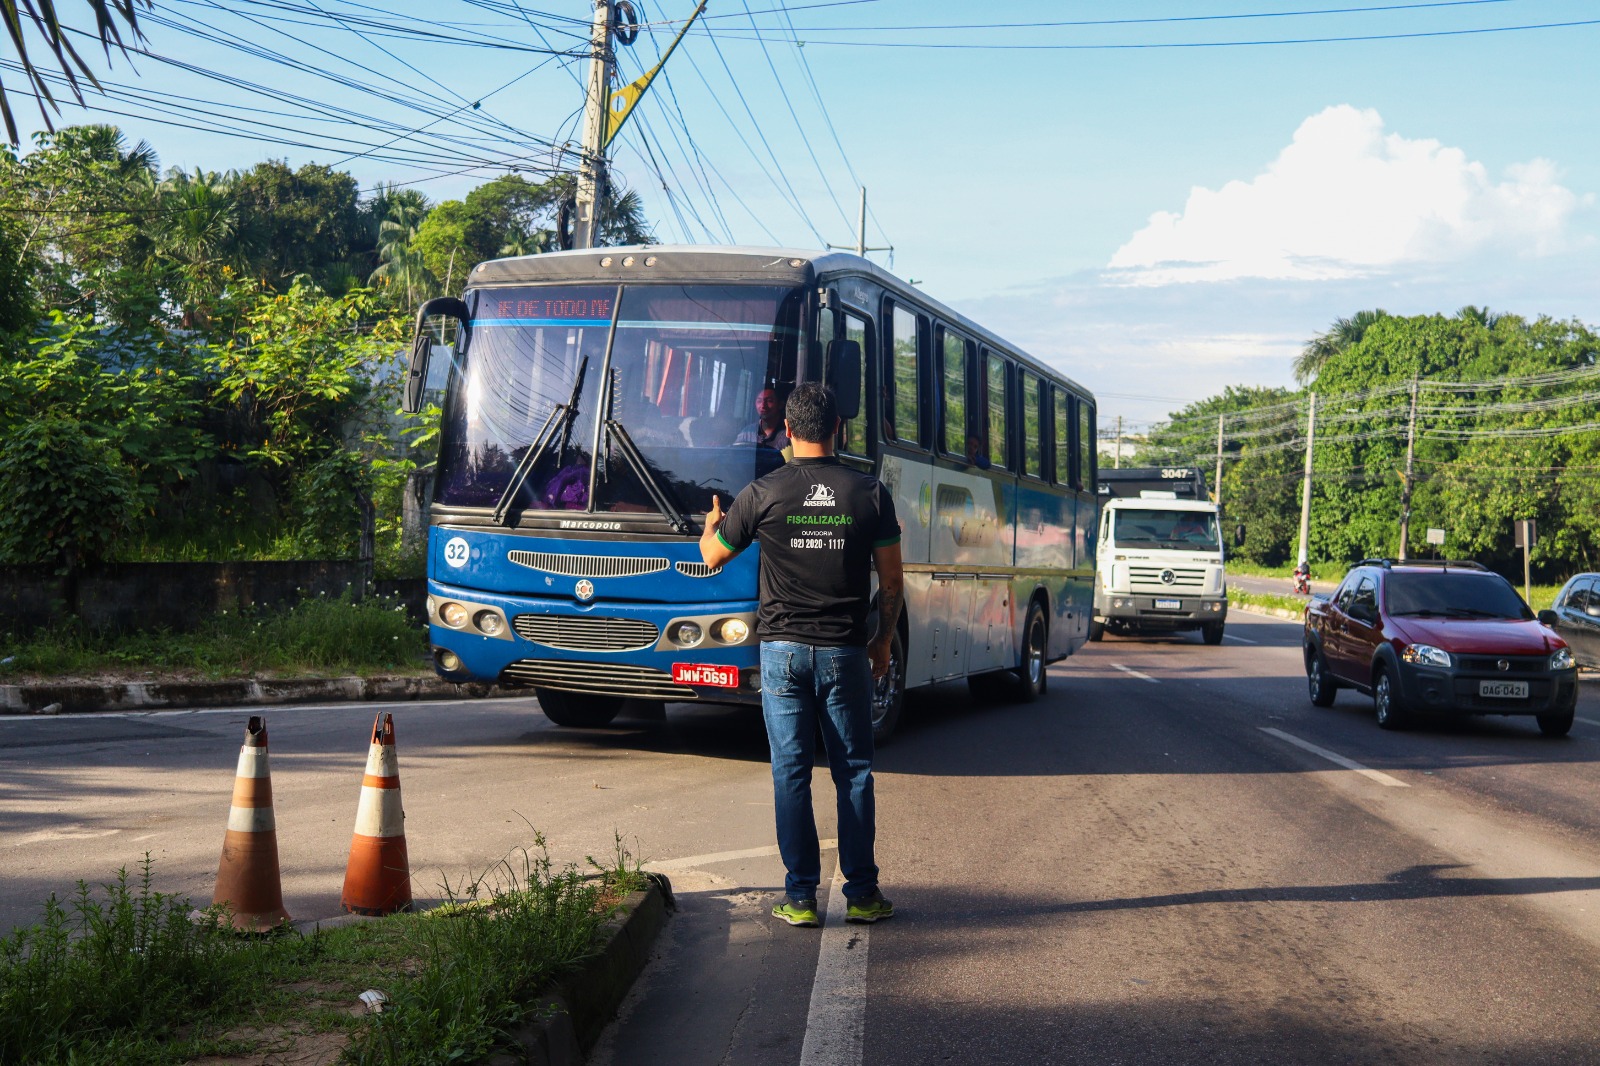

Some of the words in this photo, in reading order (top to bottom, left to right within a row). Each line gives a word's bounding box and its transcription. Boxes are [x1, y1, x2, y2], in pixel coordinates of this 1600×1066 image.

[517, 300, 540, 317] DE
[561, 520, 621, 530] Marcopolo
[786, 514, 853, 526] FISCALIZAÇÃO
[790, 538, 805, 548] (92)
[805, 539, 823, 549] 2020
[828, 539, 845, 550] 1117
[447, 543, 465, 560] 32
